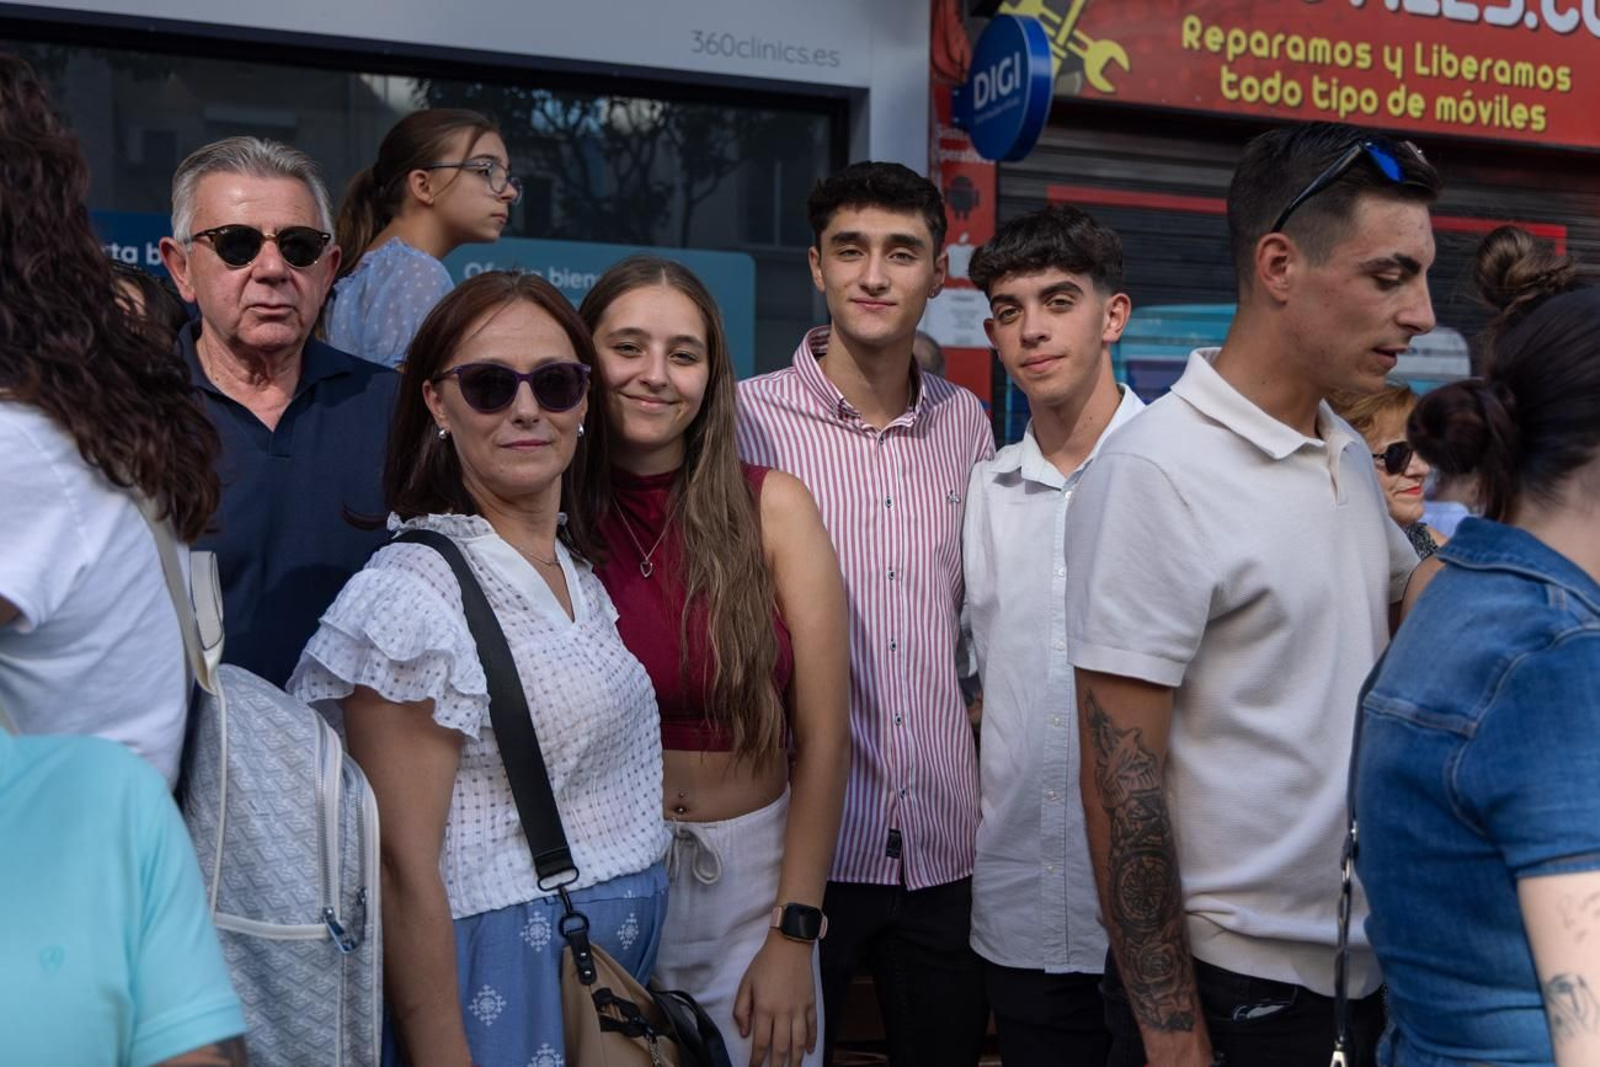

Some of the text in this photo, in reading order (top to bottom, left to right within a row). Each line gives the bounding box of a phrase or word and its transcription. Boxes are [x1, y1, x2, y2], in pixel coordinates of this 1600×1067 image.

[690, 29, 841, 68] 360clinics.es
[1182, 14, 1372, 69] Reparamos
[1383, 45, 1404, 79] y
[1414, 41, 1572, 92] Liberamos
[974, 51, 1020, 111] DIGI
[1220, 64, 1547, 131] todo tipo de móviles
